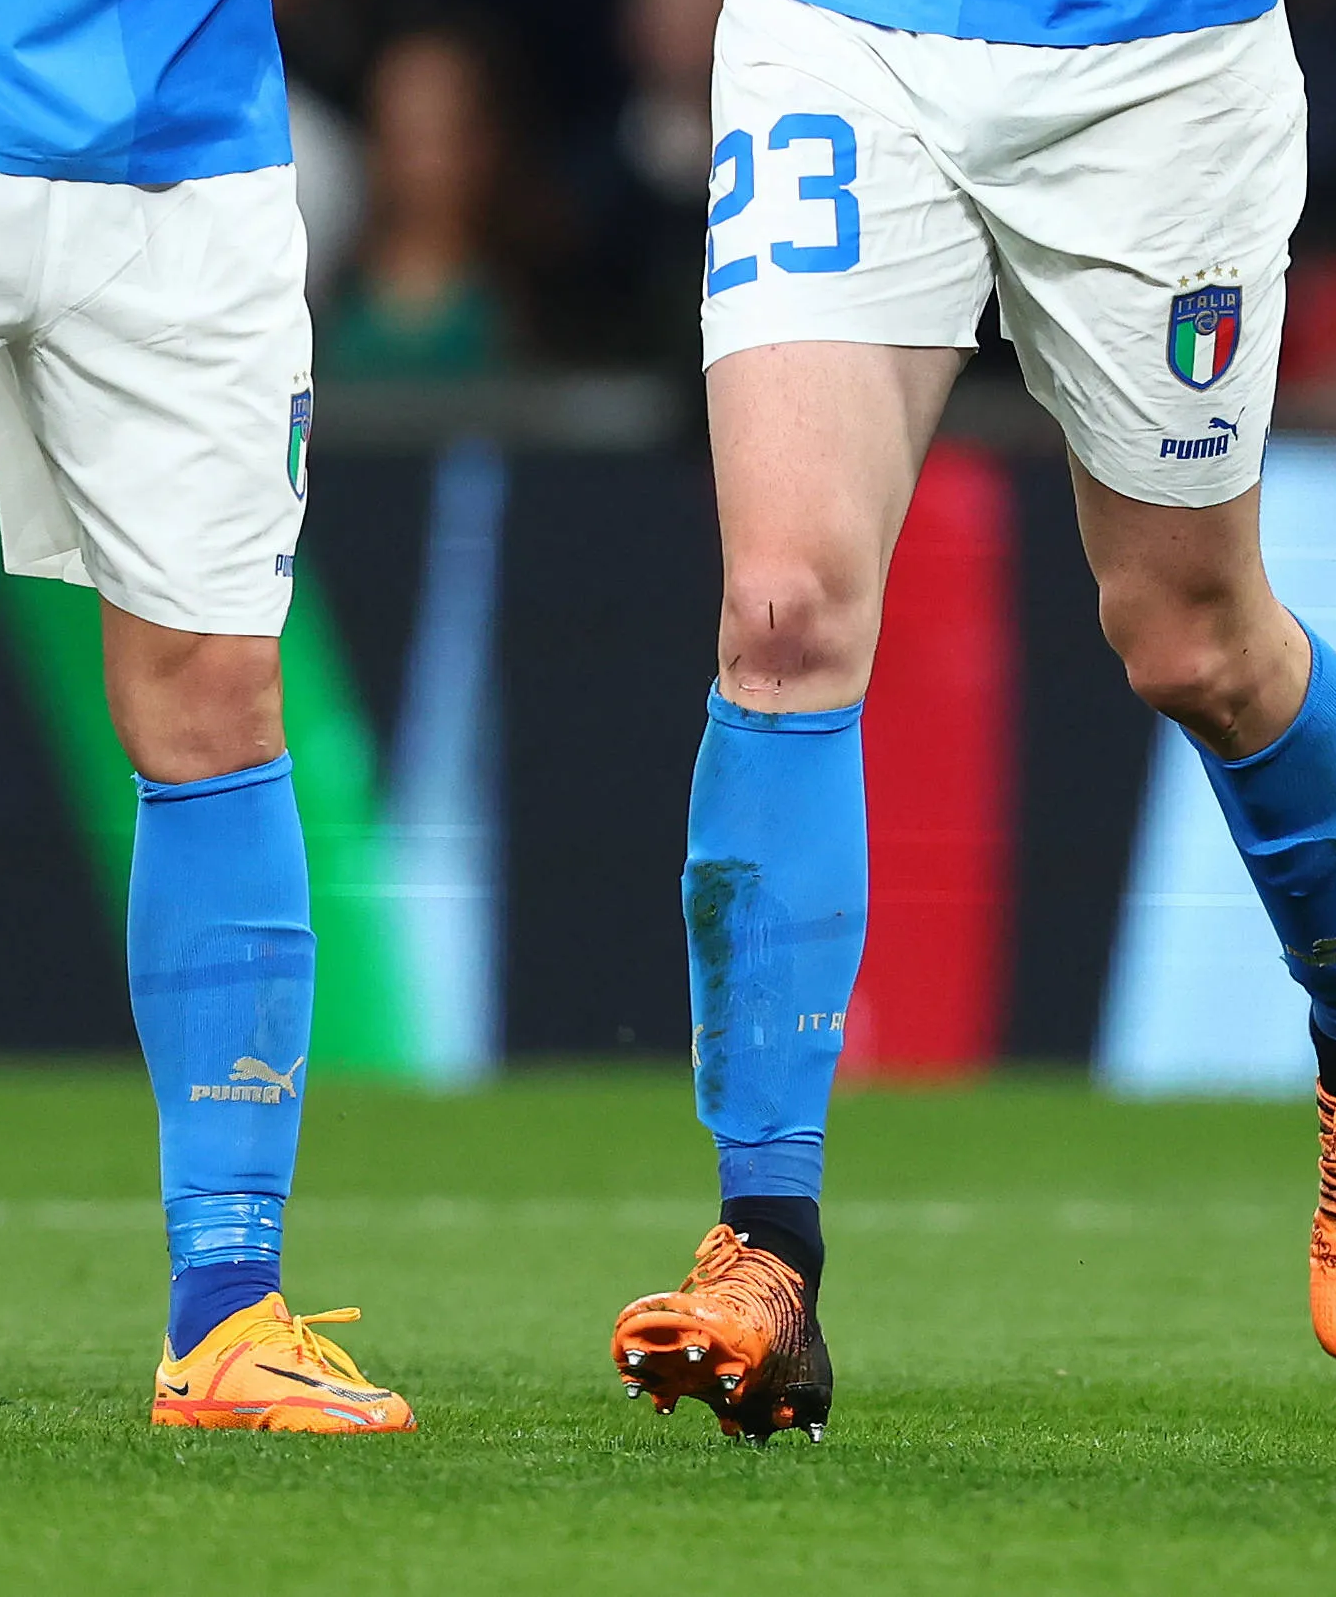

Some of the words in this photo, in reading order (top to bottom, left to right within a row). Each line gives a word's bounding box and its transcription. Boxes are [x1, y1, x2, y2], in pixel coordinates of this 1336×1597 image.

[707, 113, 860, 298] 23
[1177, 293, 1236, 313] ITALIA
[1159, 434, 1230, 460] PUMA
[190, 1085, 283, 1104] PUMA
